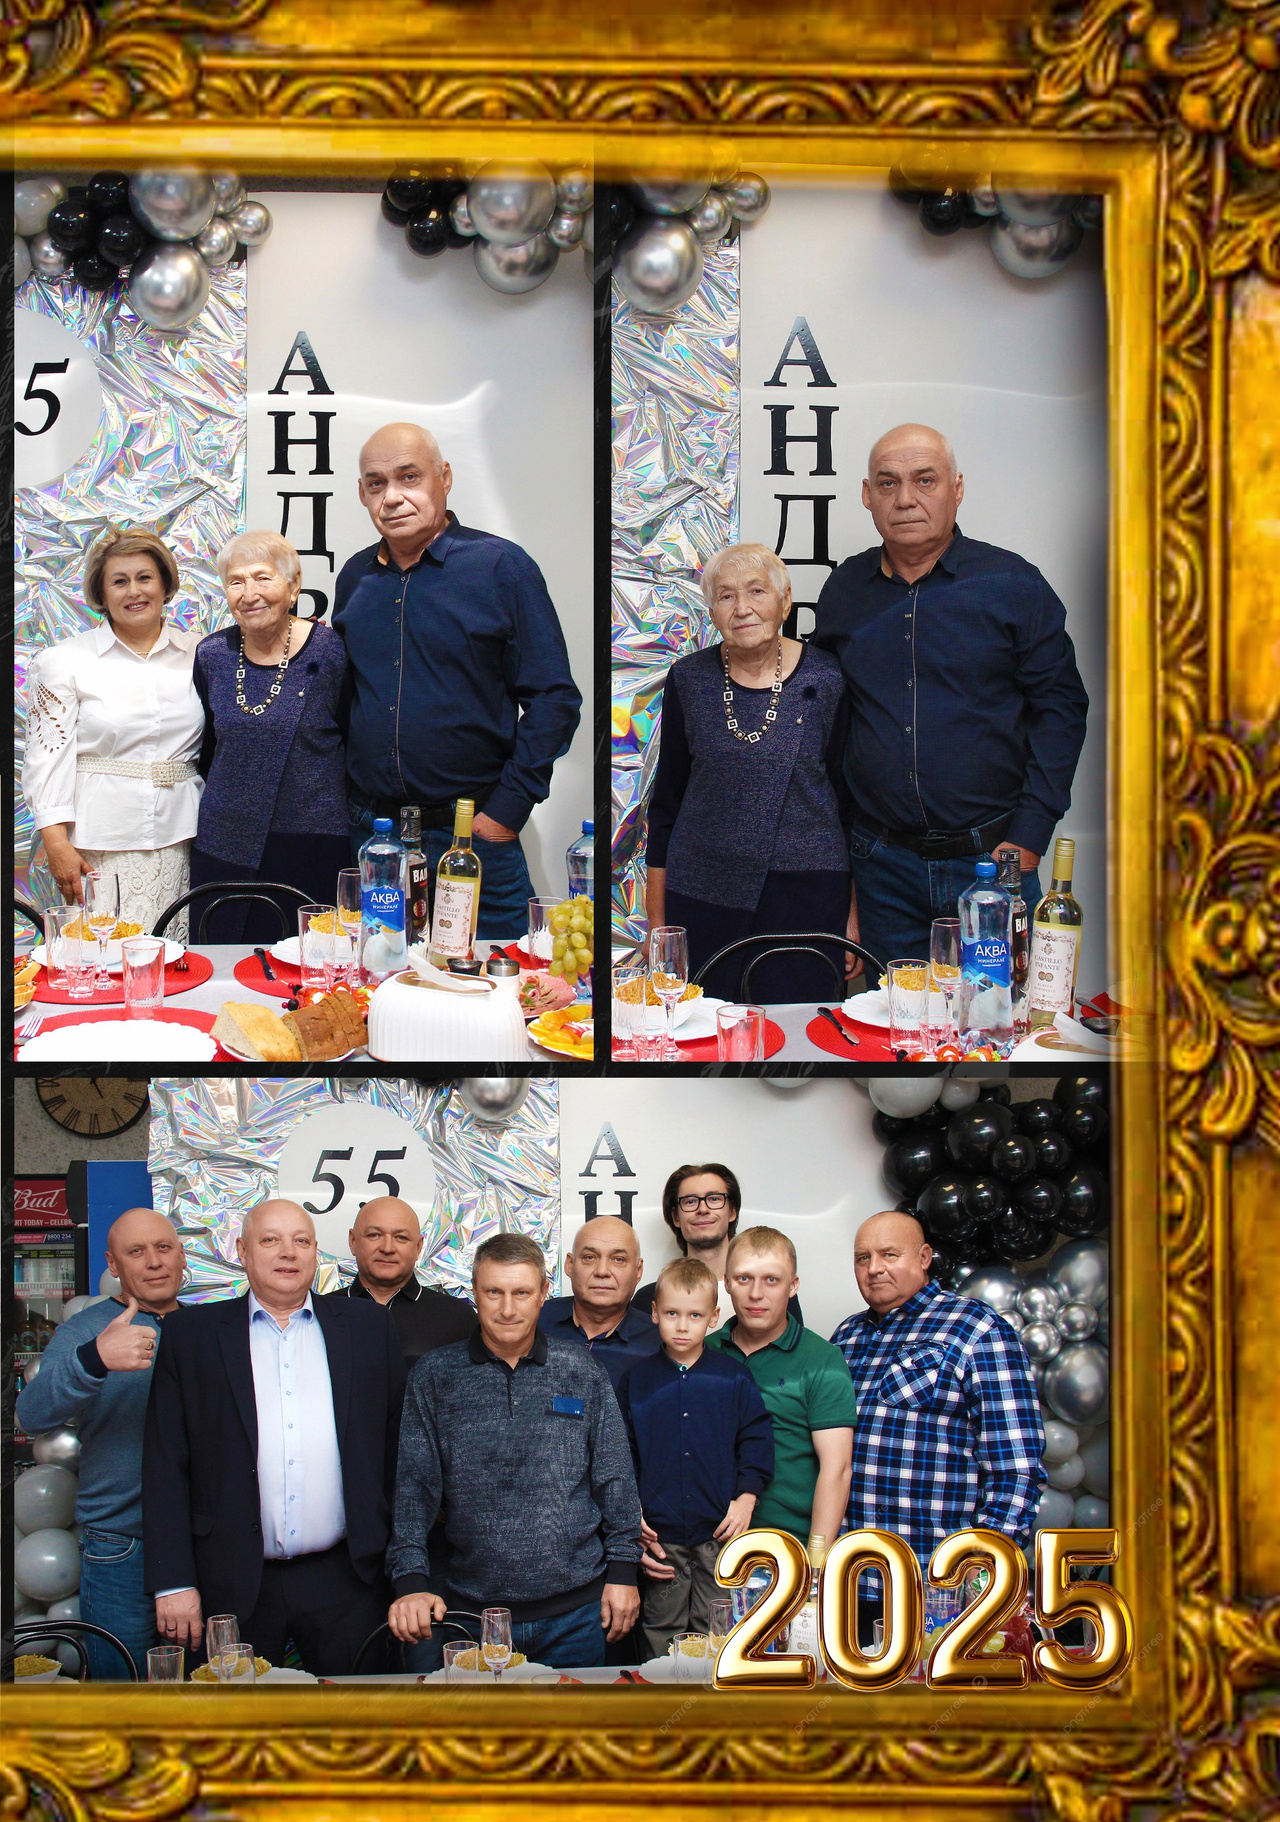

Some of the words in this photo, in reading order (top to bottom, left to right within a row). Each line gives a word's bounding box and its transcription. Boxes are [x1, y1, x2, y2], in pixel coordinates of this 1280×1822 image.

[370, 891, 400, 905] АКВА
[974, 943, 1008, 958] АКВА
[302, 1146, 408, 1215] 55
[14, 1188, 60, 1210] Bud
